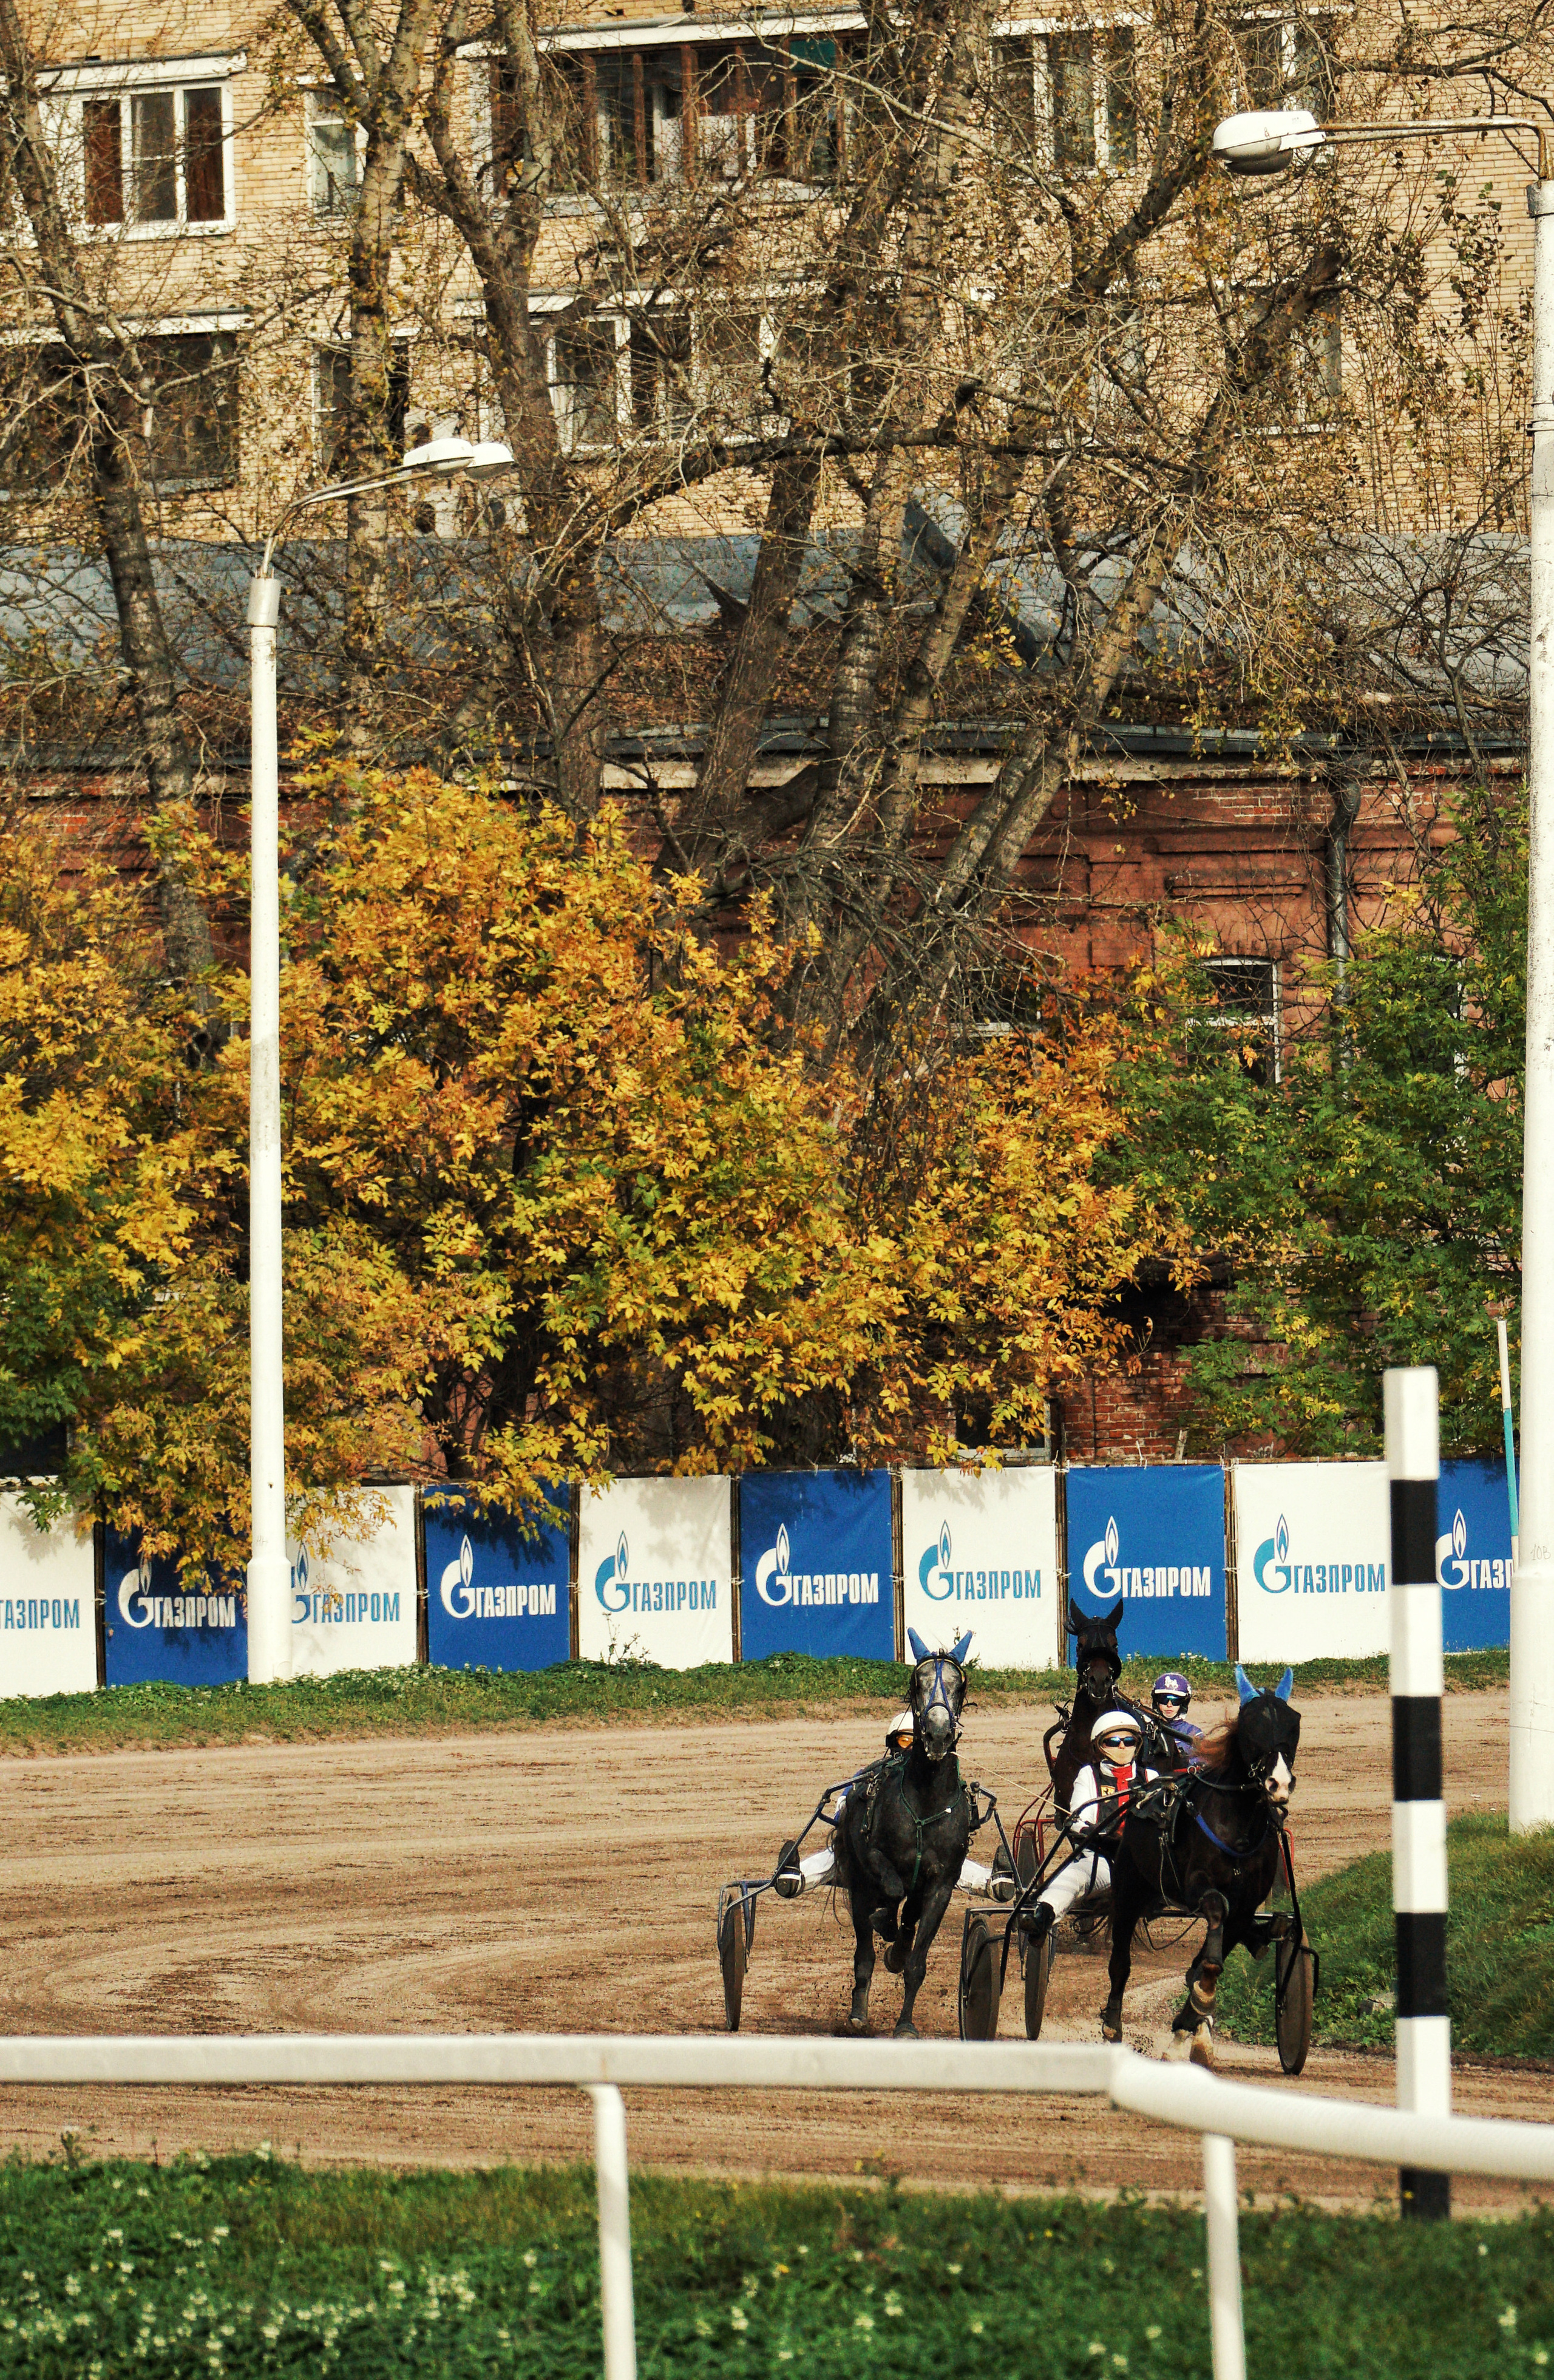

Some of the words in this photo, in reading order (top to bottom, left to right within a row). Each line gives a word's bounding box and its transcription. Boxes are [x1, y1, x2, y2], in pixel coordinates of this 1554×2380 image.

[791, 1573, 879, 1605] ГАЗПРОМ
[955, 1569, 1042, 1600] ГАЗПРОМ
[1122, 1566, 1211, 1597] ГАЗПРОМ
[1294, 1563, 1386, 1594] ГАЗПРОМ
[1470, 1559, 1515, 1589] ГАЗП
[313, 1592, 400, 1623] ГАЗПРОМ
[475, 1584, 556, 1617] ГАЗПРОМ
[632, 1580, 717, 1612] ГАЗПРОМ
[155, 1597, 236, 1628] ГАЗПРОМ
